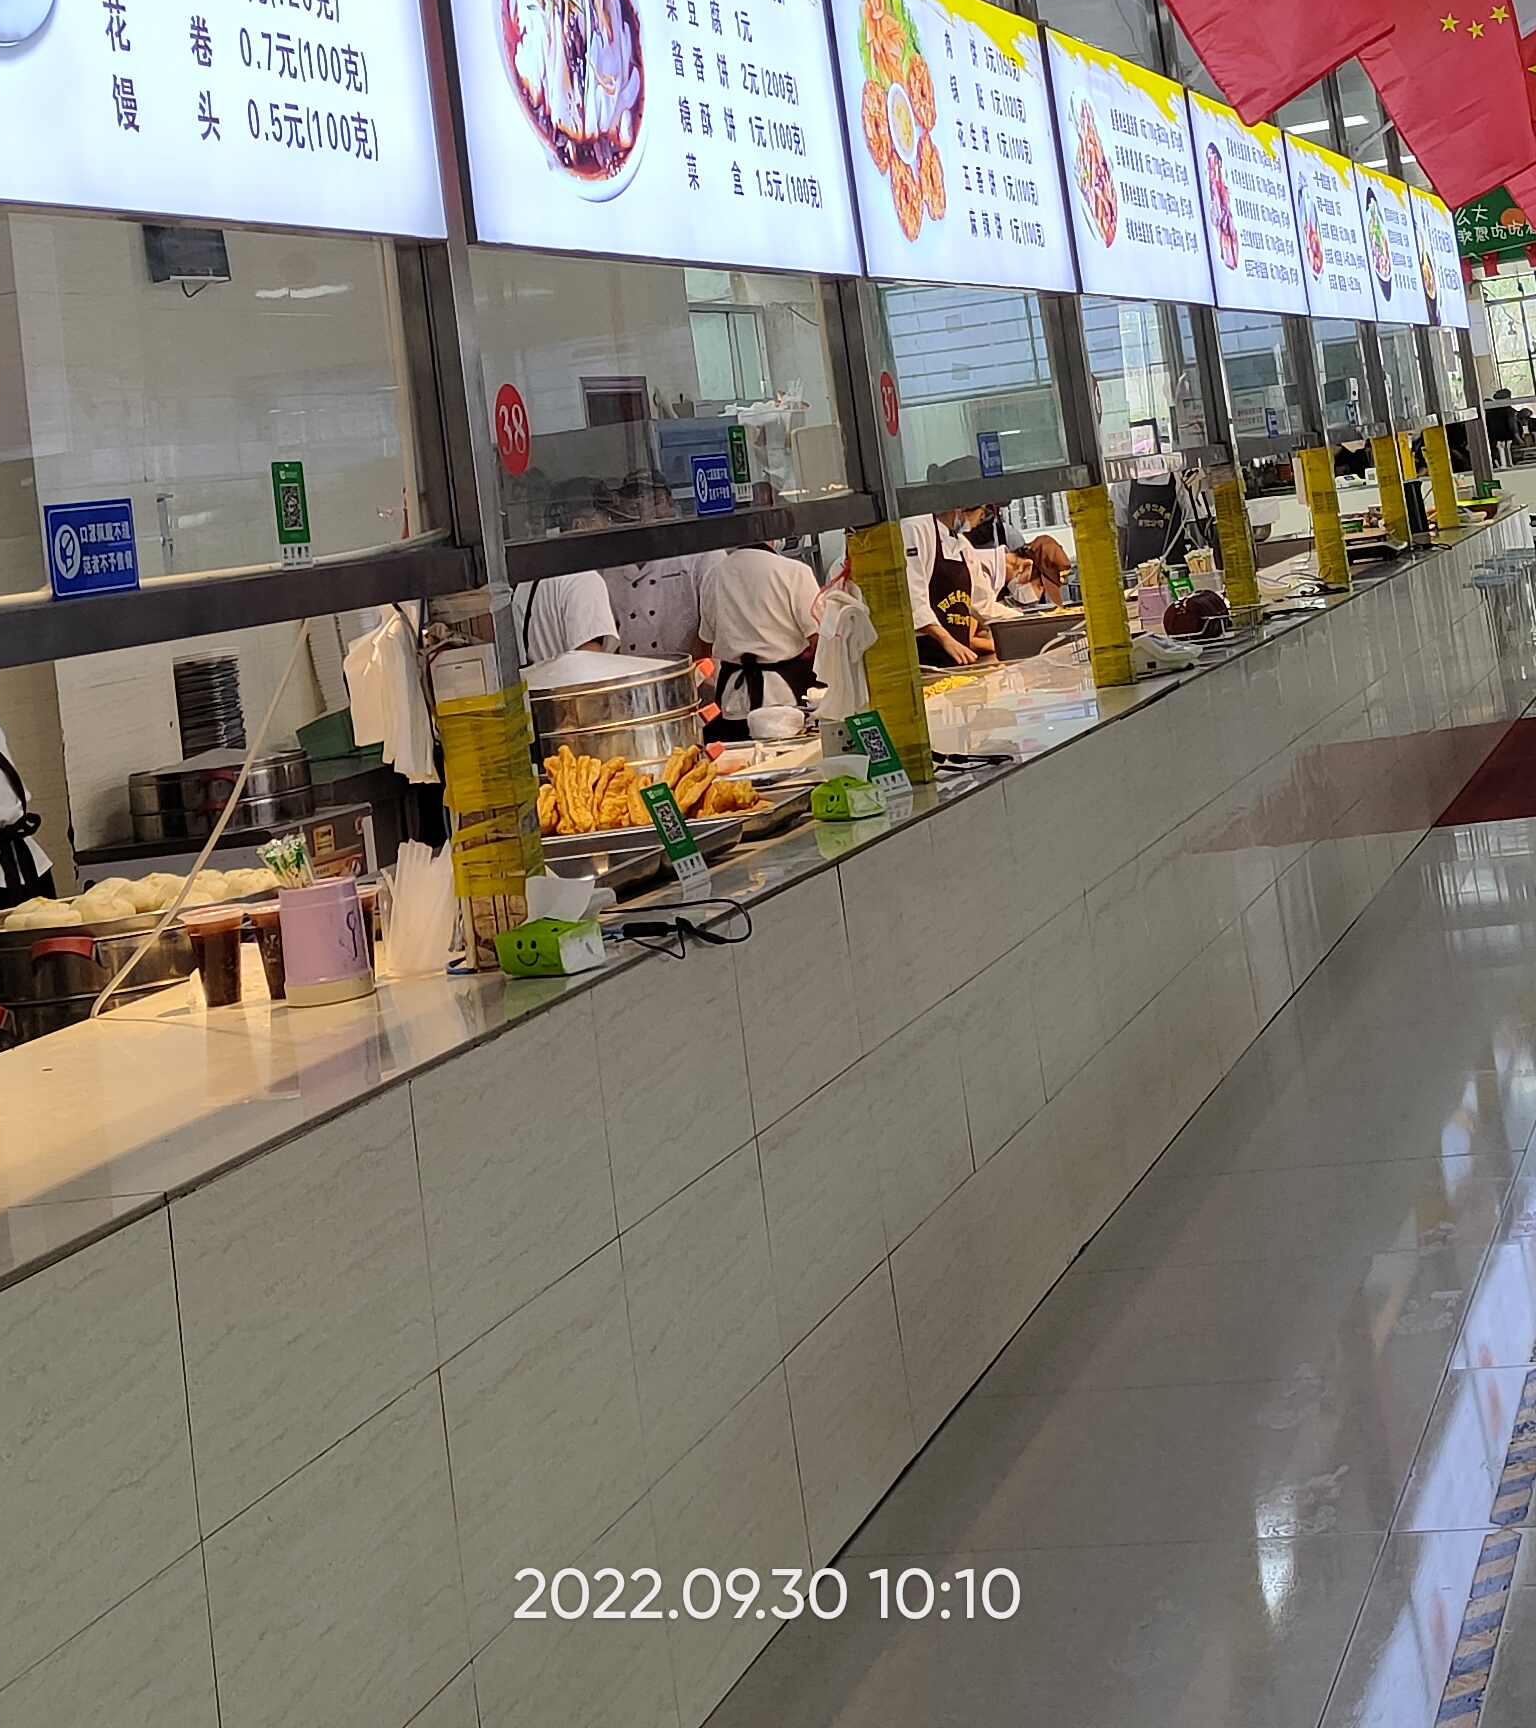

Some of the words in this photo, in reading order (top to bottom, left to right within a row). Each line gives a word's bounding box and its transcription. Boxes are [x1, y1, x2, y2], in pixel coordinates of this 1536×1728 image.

[239, 27, 369, 95] 0.7元(100克)
[247, 98, 379, 161] 0.5元(100克)
[496, 403, 526, 456] 38
